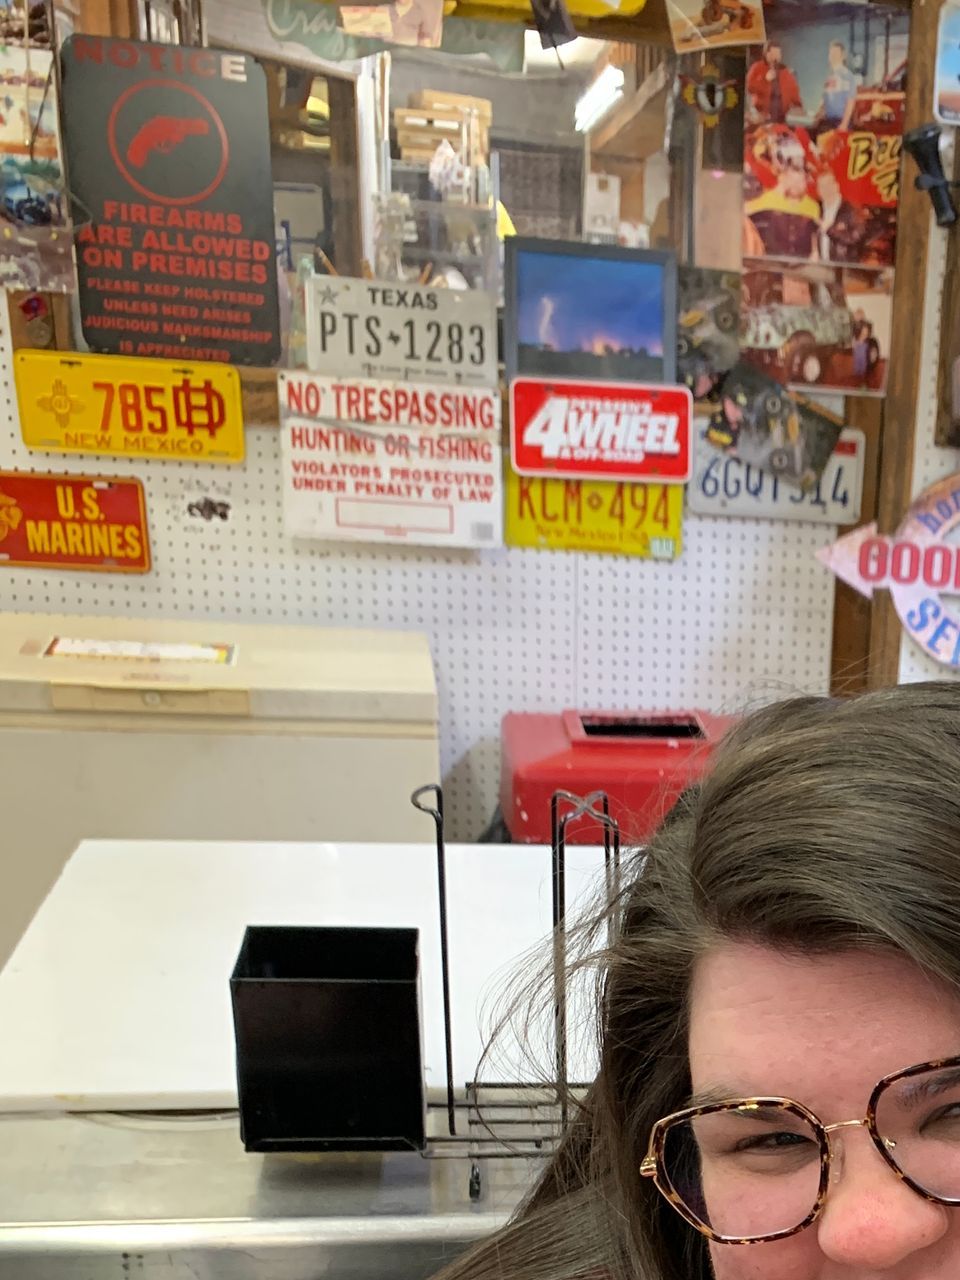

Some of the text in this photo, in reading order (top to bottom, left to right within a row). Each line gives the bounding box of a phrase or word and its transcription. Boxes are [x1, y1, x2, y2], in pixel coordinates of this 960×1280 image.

[73, 38, 247, 82] NOTICE
[104, 201, 242, 234] FIREARMS
[79, 224, 270, 261] ARE ALLOWED
[83, 248, 267, 284] ON PREMISES
[87, 278, 264, 306] PLEASE KEEP HOLSTERED
[104, 298, 158, 315] UNLESS
[162, 304, 198, 318] NEED
[367, 287, 438, 310] TEXAS
[85, 315, 272, 343] JUDICIOUS MARKSMANSHIP
[287, 381, 495, 429] NO TRESPASSING
[65, 432, 204, 453] NEW MEXICO
[291, 427, 493, 464] HUNTING OR FISHING
[292, 460, 494, 487] VIOLATORS PROSECUTED
[292, 477, 493, 503] UNDER PENALTY OF LAW
[56, 485, 105, 521] U.S.
[26, 519, 141, 559] MARINES
